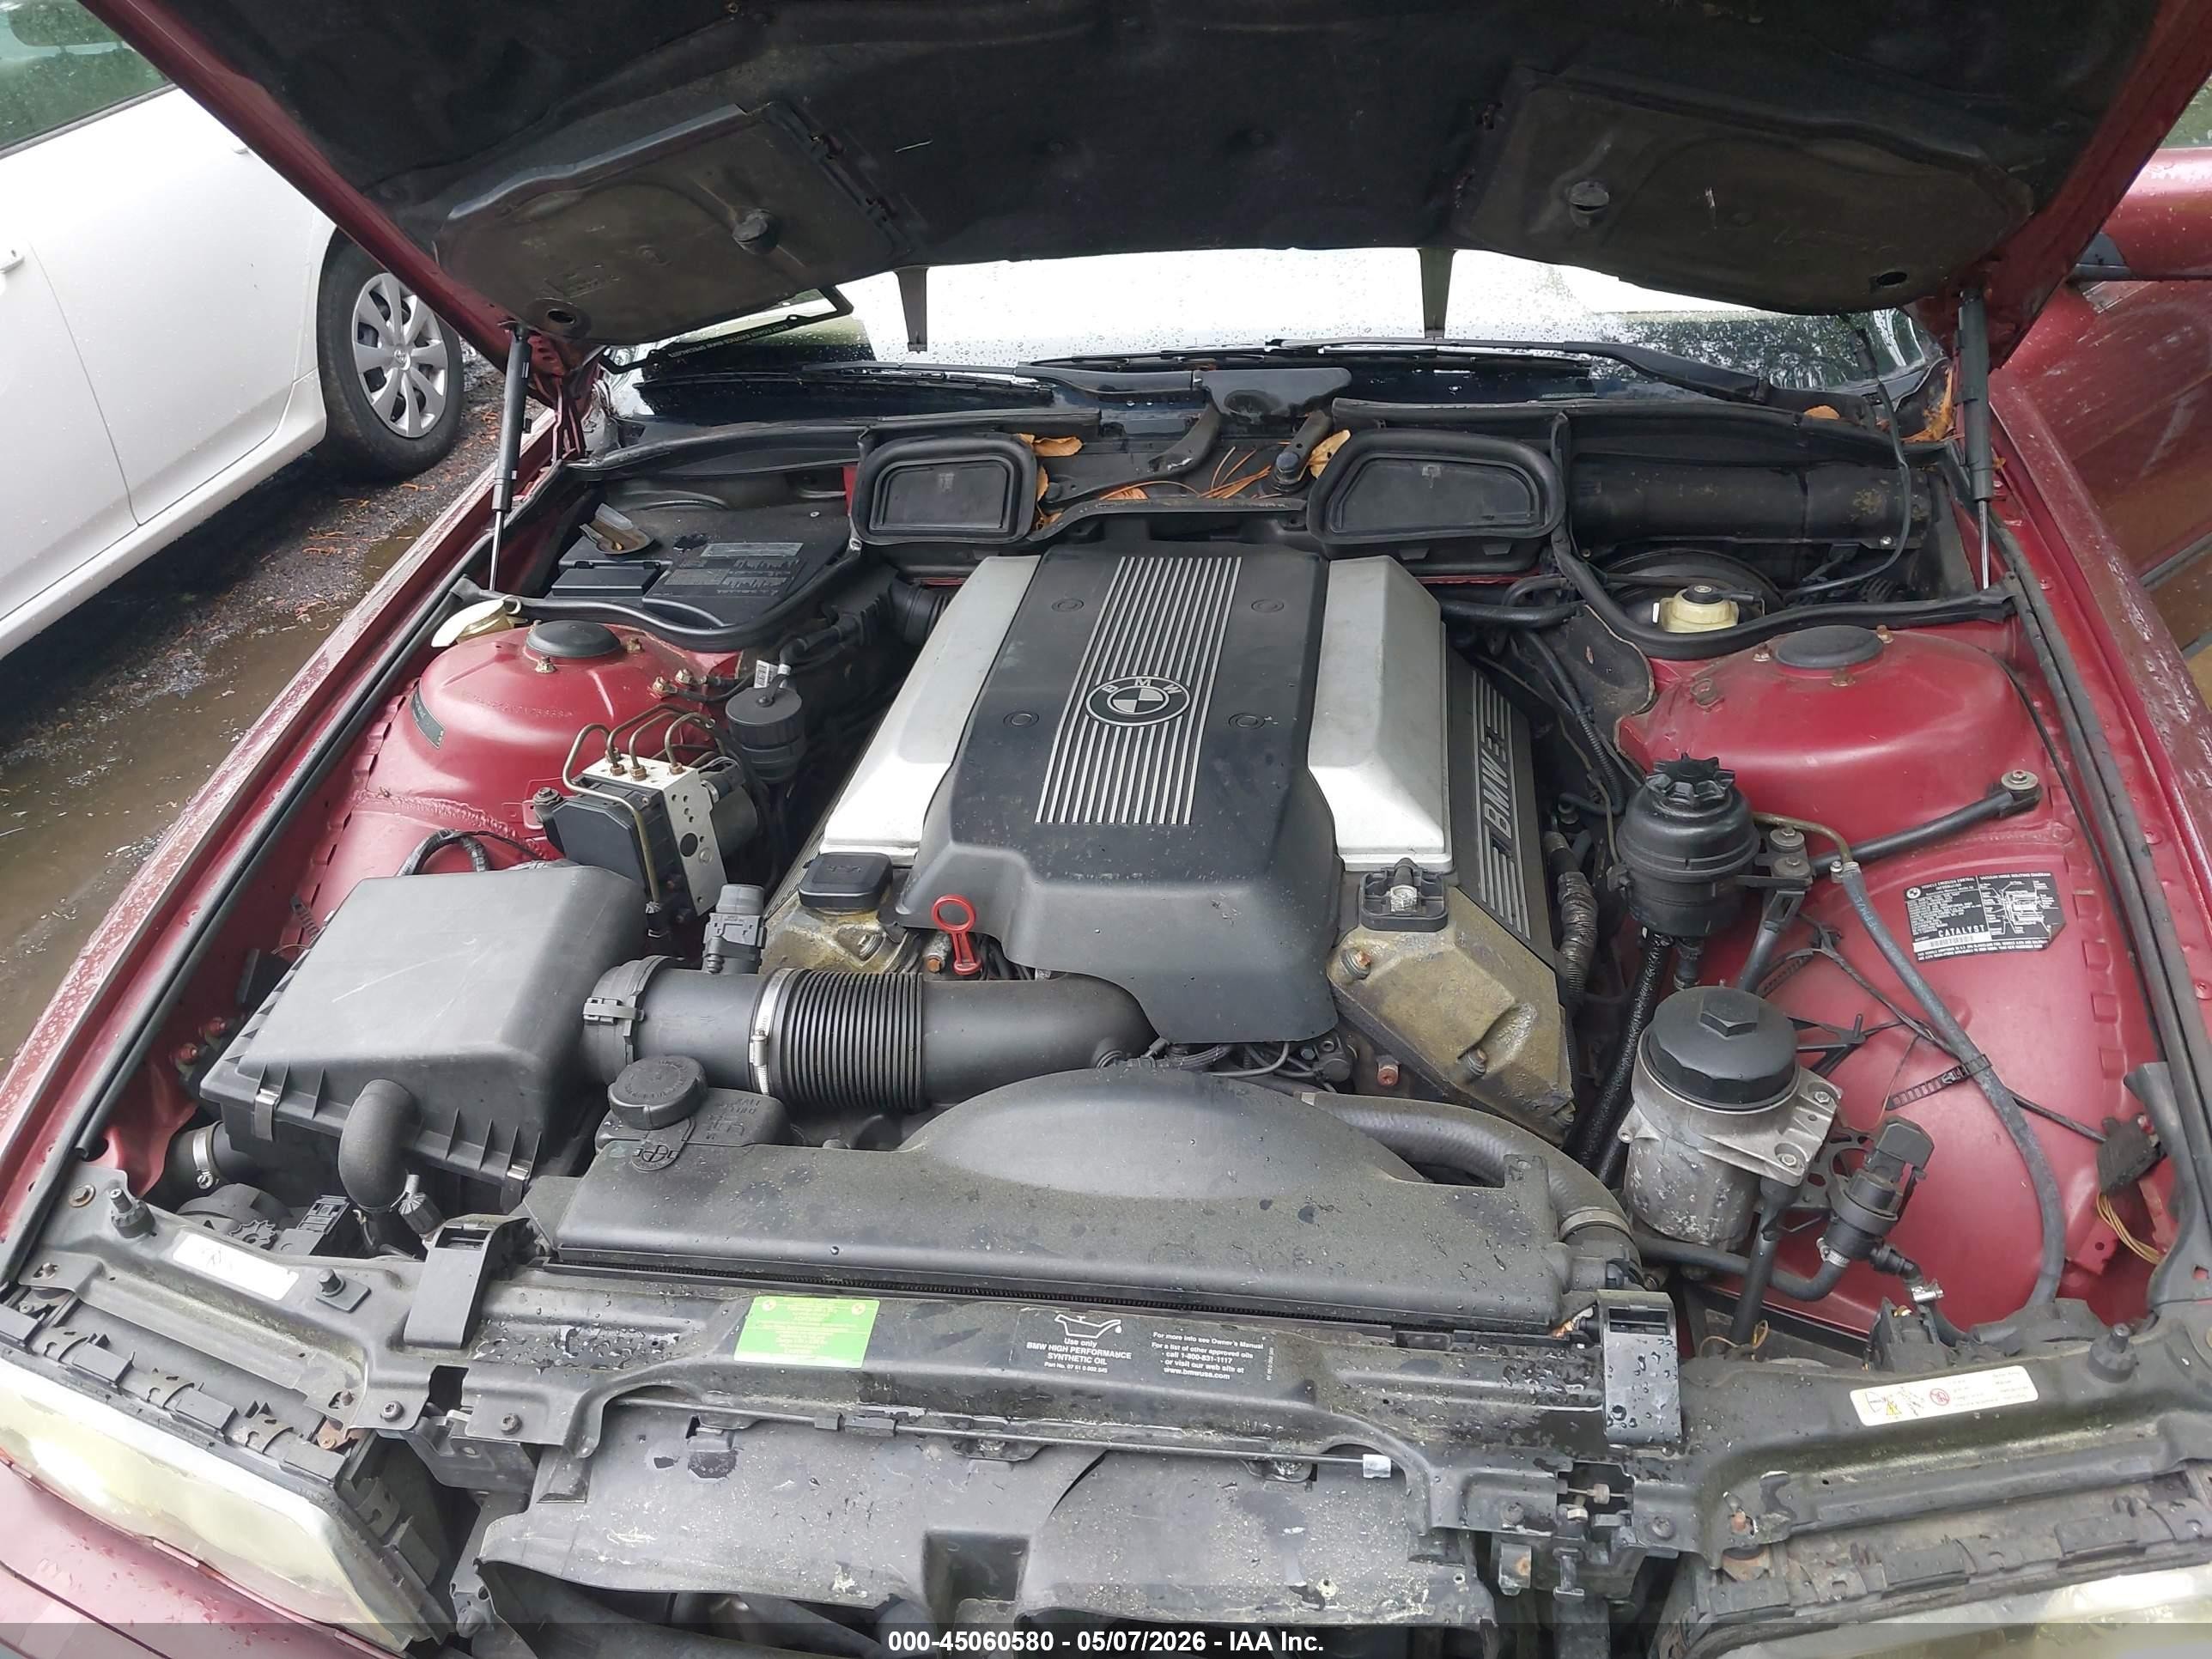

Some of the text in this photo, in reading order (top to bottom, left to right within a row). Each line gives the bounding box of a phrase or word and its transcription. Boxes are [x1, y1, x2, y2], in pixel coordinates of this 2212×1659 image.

[1481, 748, 1511, 839] BMW
[1938, 924, 1984, 938] CATALYST
[1064, 1338, 1097, 1348] Use only
[1212, 1338, 1238, 1346] Owner's
[1240, 1341, 1264, 1350] Manual
[1026, 1341, 1132, 1359] BMW HIGH PERFORMANCE
[1208, 1348, 1240, 1358] approved
[1048, 1352, 1092, 1364] SYNTHETIC
[1181, 1352, 1233, 1364] 1-800-831-1117
[1164, 1366, 1231, 1380] www.bmwusa.com
